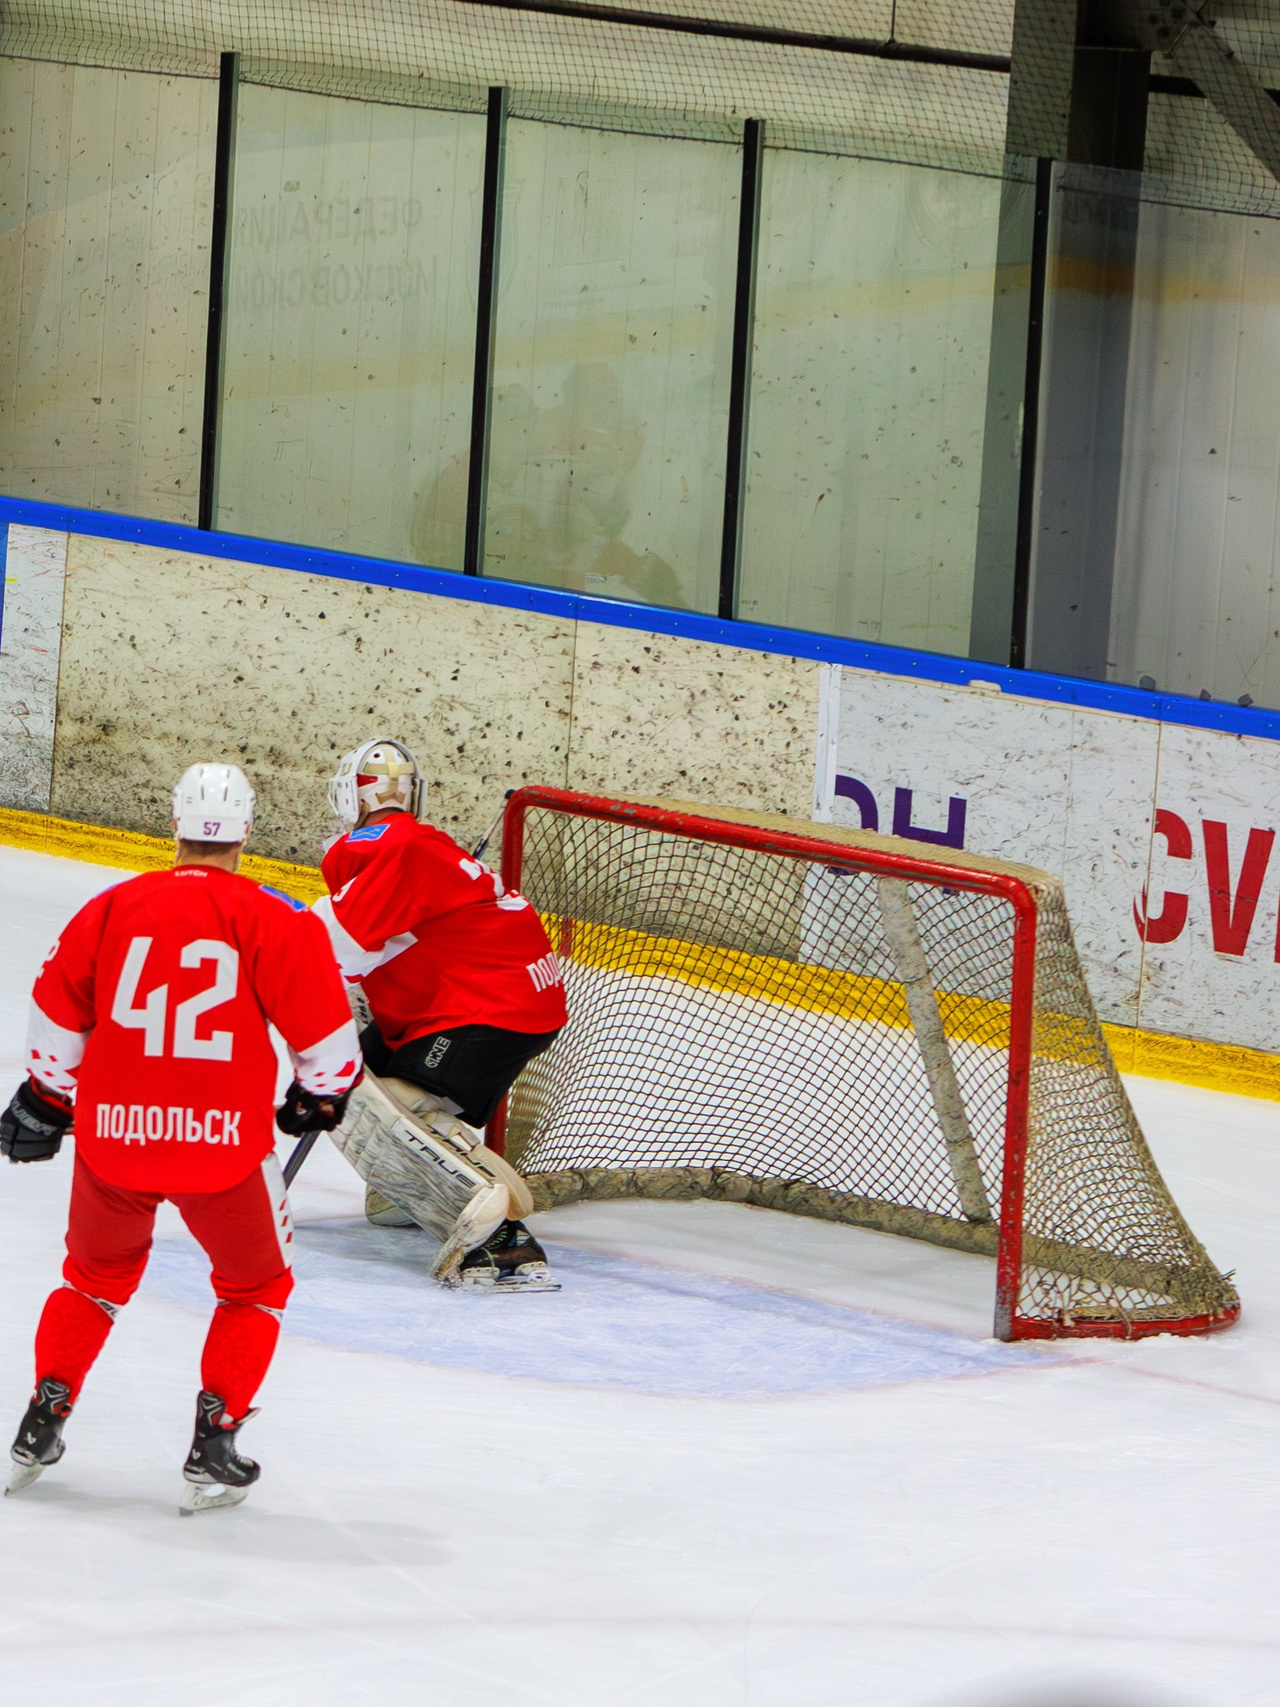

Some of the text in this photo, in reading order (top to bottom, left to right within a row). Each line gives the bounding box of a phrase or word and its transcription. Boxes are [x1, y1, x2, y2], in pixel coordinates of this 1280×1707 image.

[203, 821, 222, 837] 57
[1133, 808, 1280, 964] CV
[111, 936, 240, 1062] 42
[96, 1103, 242, 1146] ПОДОЛЬСК
[404, 1129, 477, 1189] TRUE
